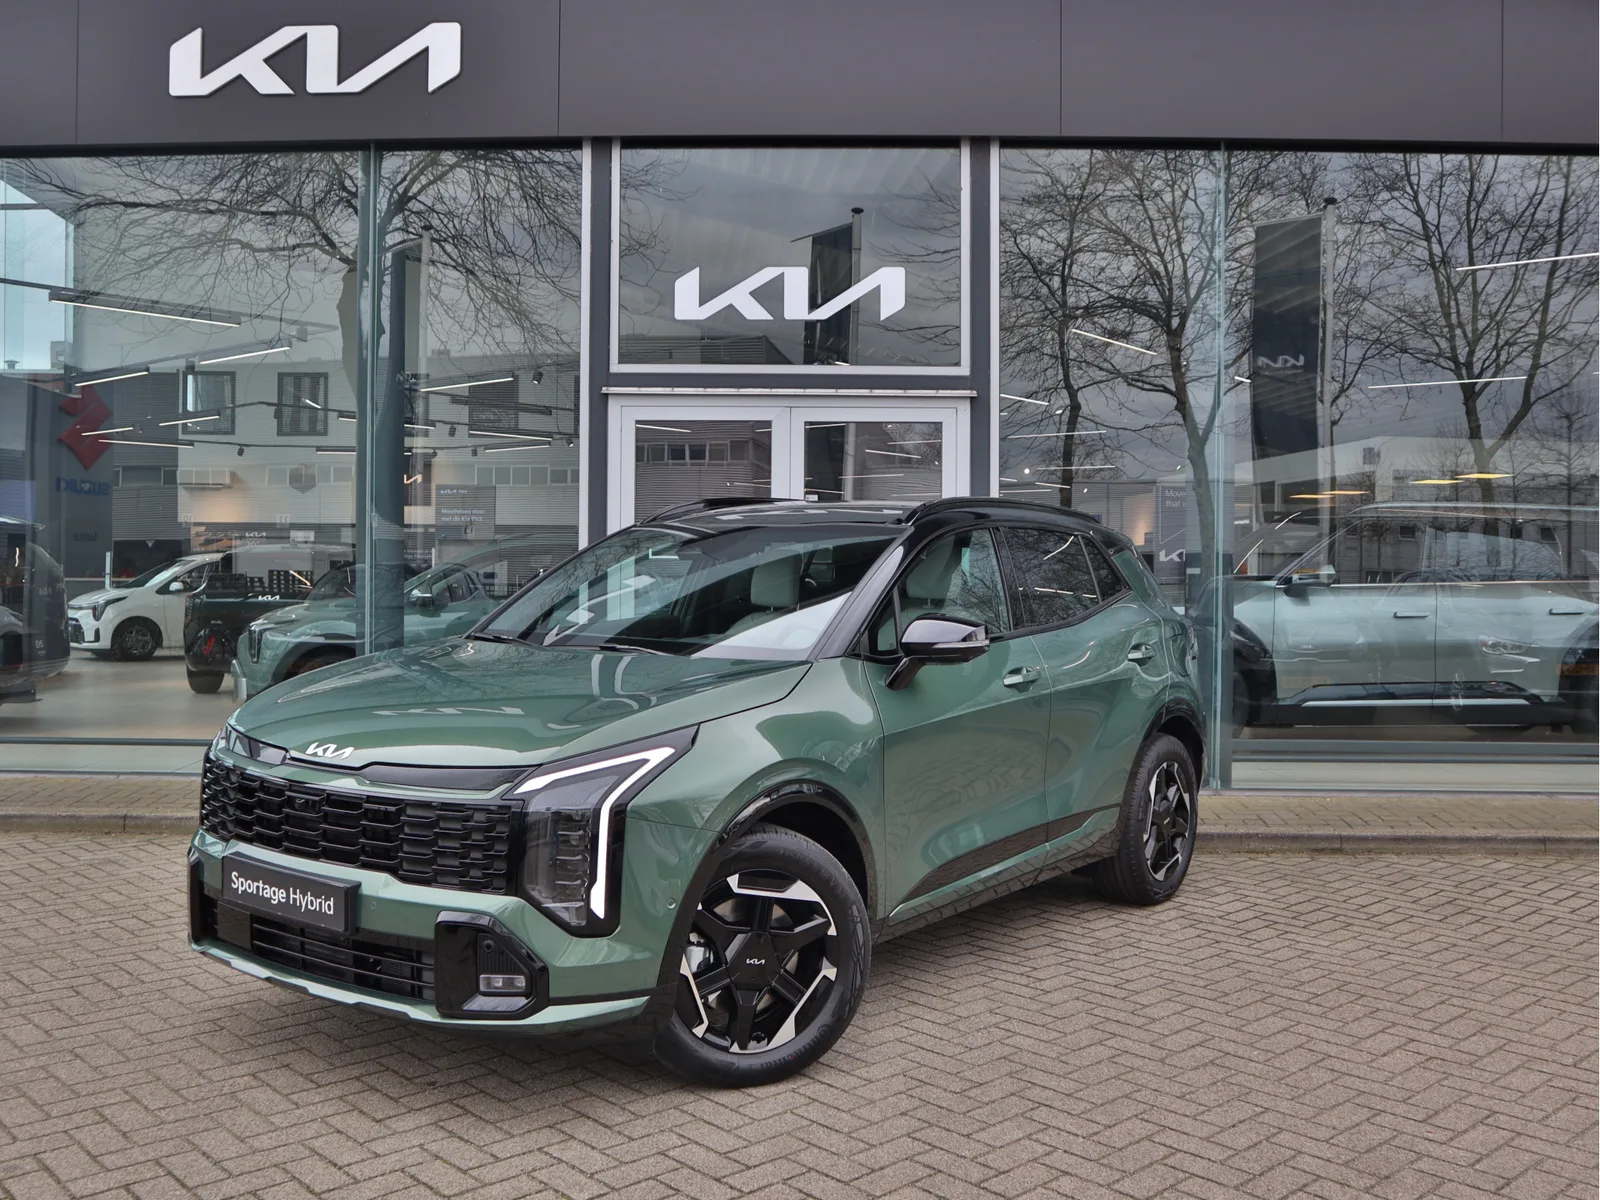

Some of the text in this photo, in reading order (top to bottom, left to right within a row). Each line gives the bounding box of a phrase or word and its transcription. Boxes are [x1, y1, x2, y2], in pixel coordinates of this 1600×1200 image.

[169, 22, 462, 97] KIA
[674, 266, 906, 321] KIA
[305, 741, 355, 761] KIA
[231, 871, 335, 915] Sportage Hybrid
[746, 957, 766, 965] KIA
